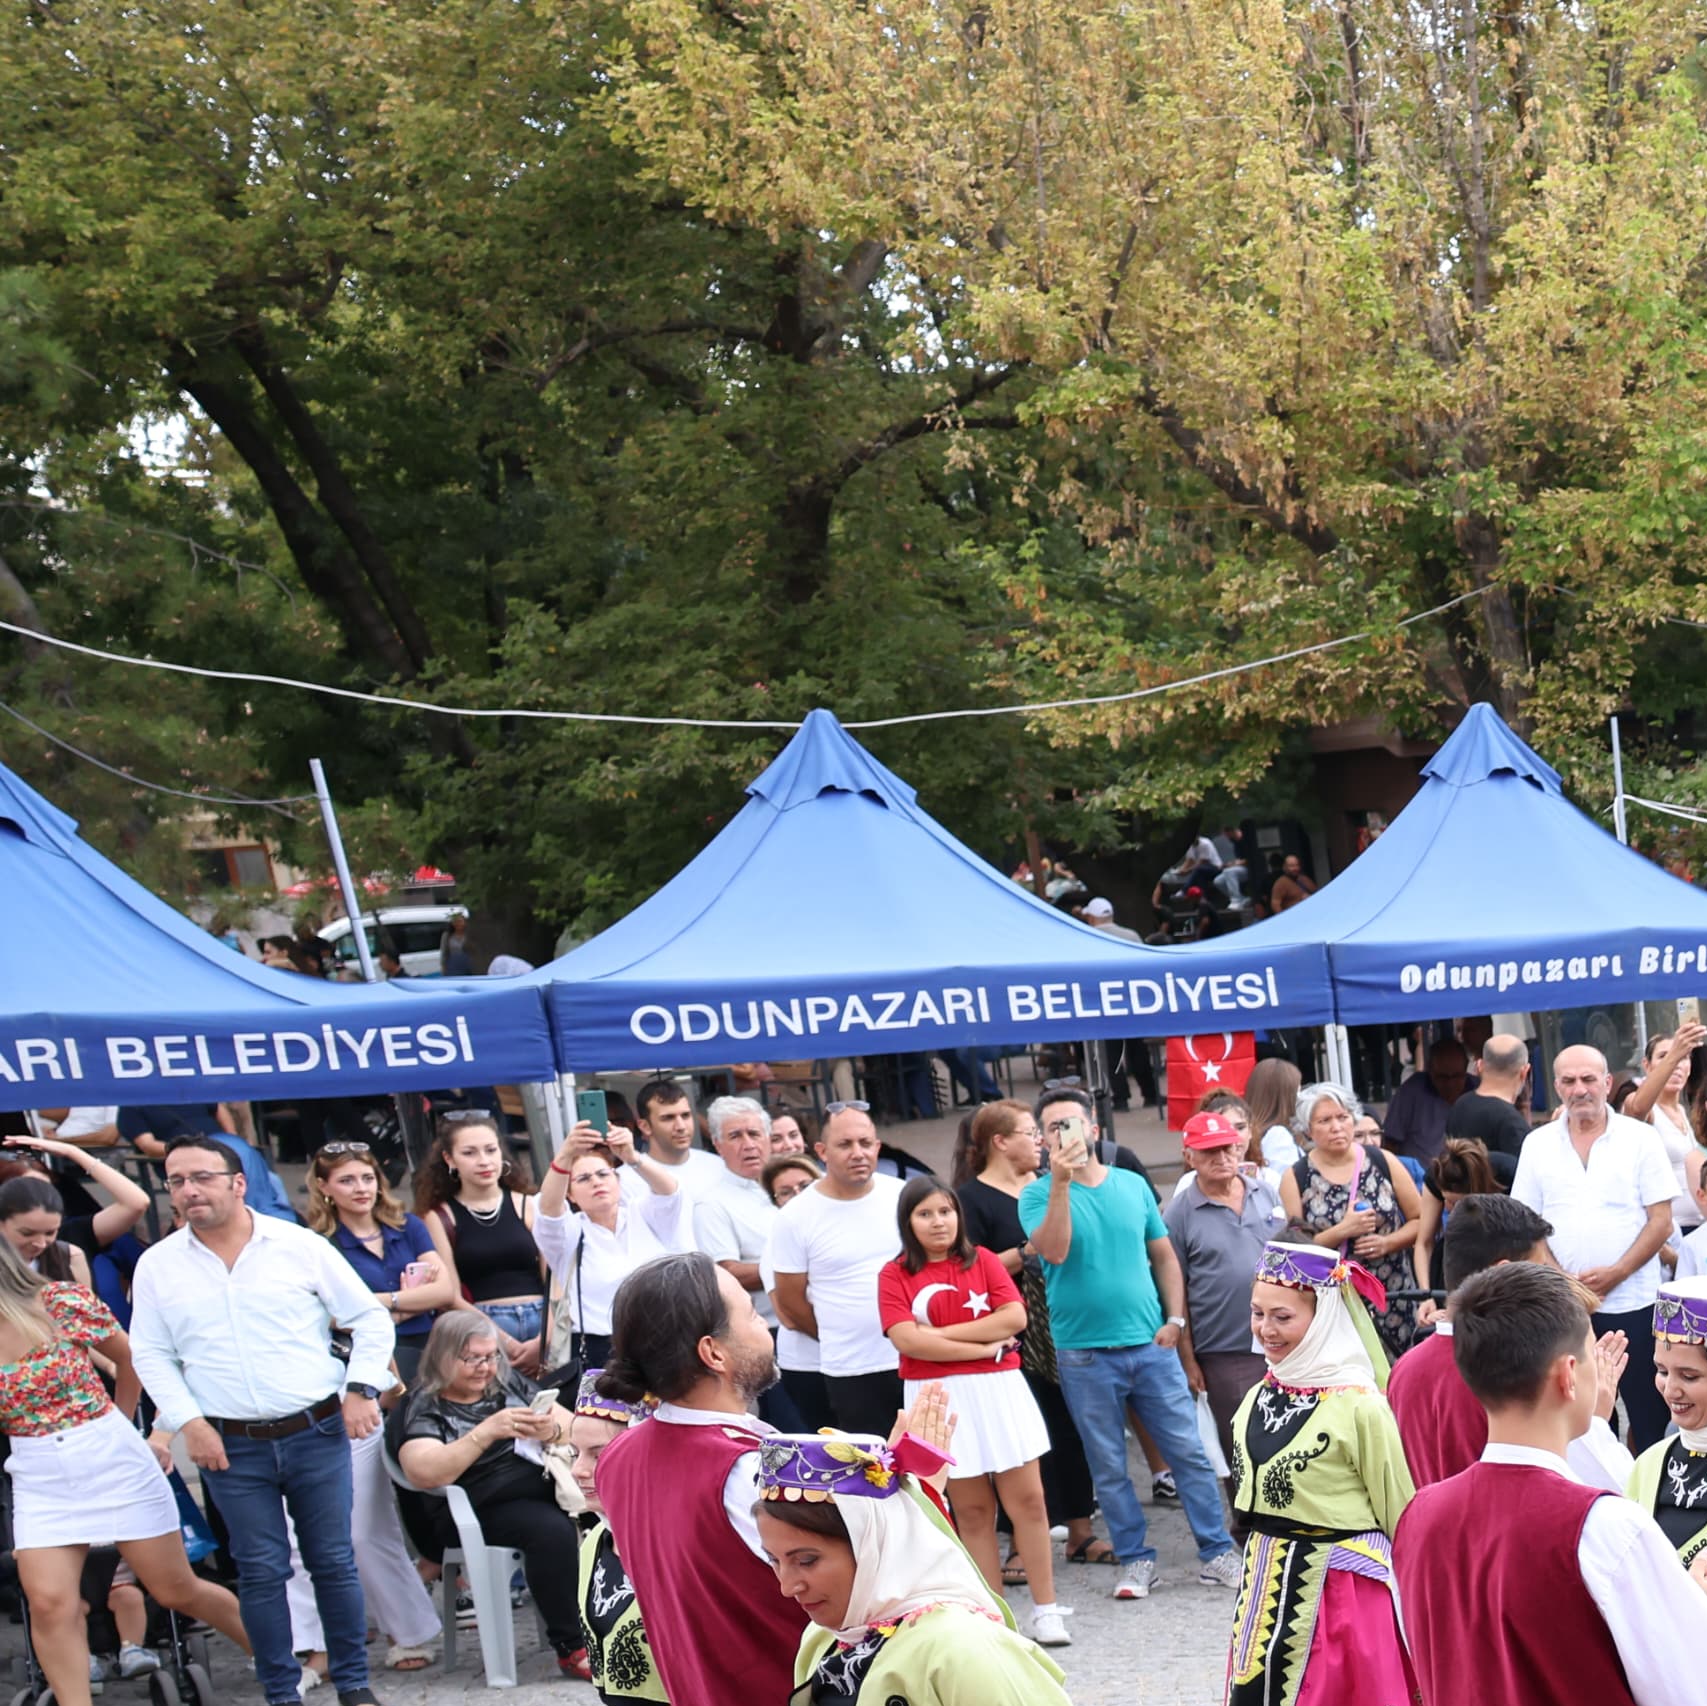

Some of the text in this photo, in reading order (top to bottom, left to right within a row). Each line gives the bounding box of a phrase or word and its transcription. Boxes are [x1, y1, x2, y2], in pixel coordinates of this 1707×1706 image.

[630, 966, 1279, 1044] ODUNPAZARI BELEDİYESİ
[1400, 956, 1624, 993] Odunpazarı
[105, 1015, 475, 1079] BELEDİYESİ
